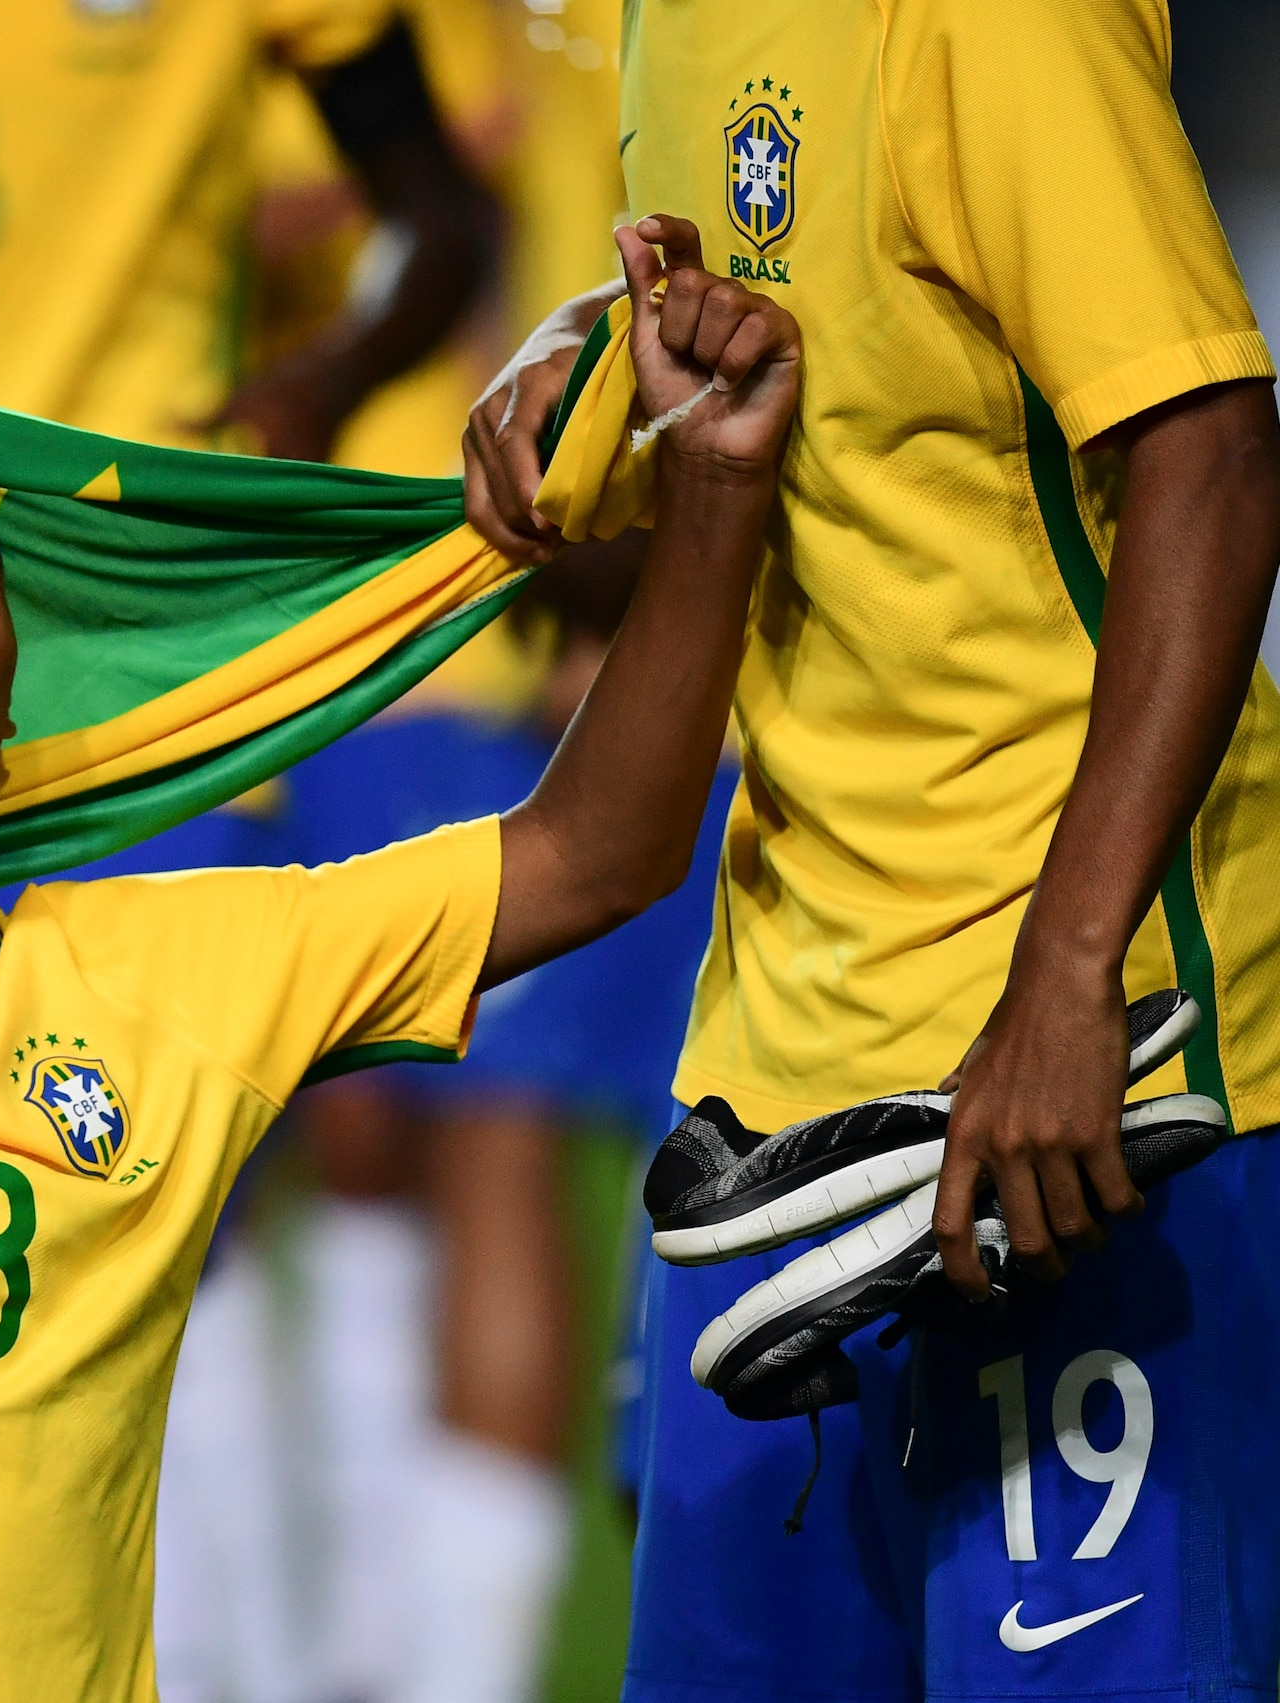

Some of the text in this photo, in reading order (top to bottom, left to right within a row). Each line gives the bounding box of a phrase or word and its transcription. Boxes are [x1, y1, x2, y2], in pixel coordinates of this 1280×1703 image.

[747, 163, 772, 182] CBF
[72, 1094, 99, 1118] CBF
[118, 1158, 160, 1186] SIL
[785, 1198, 824, 1221] FREE
[978, 1349, 1154, 1562] 19
